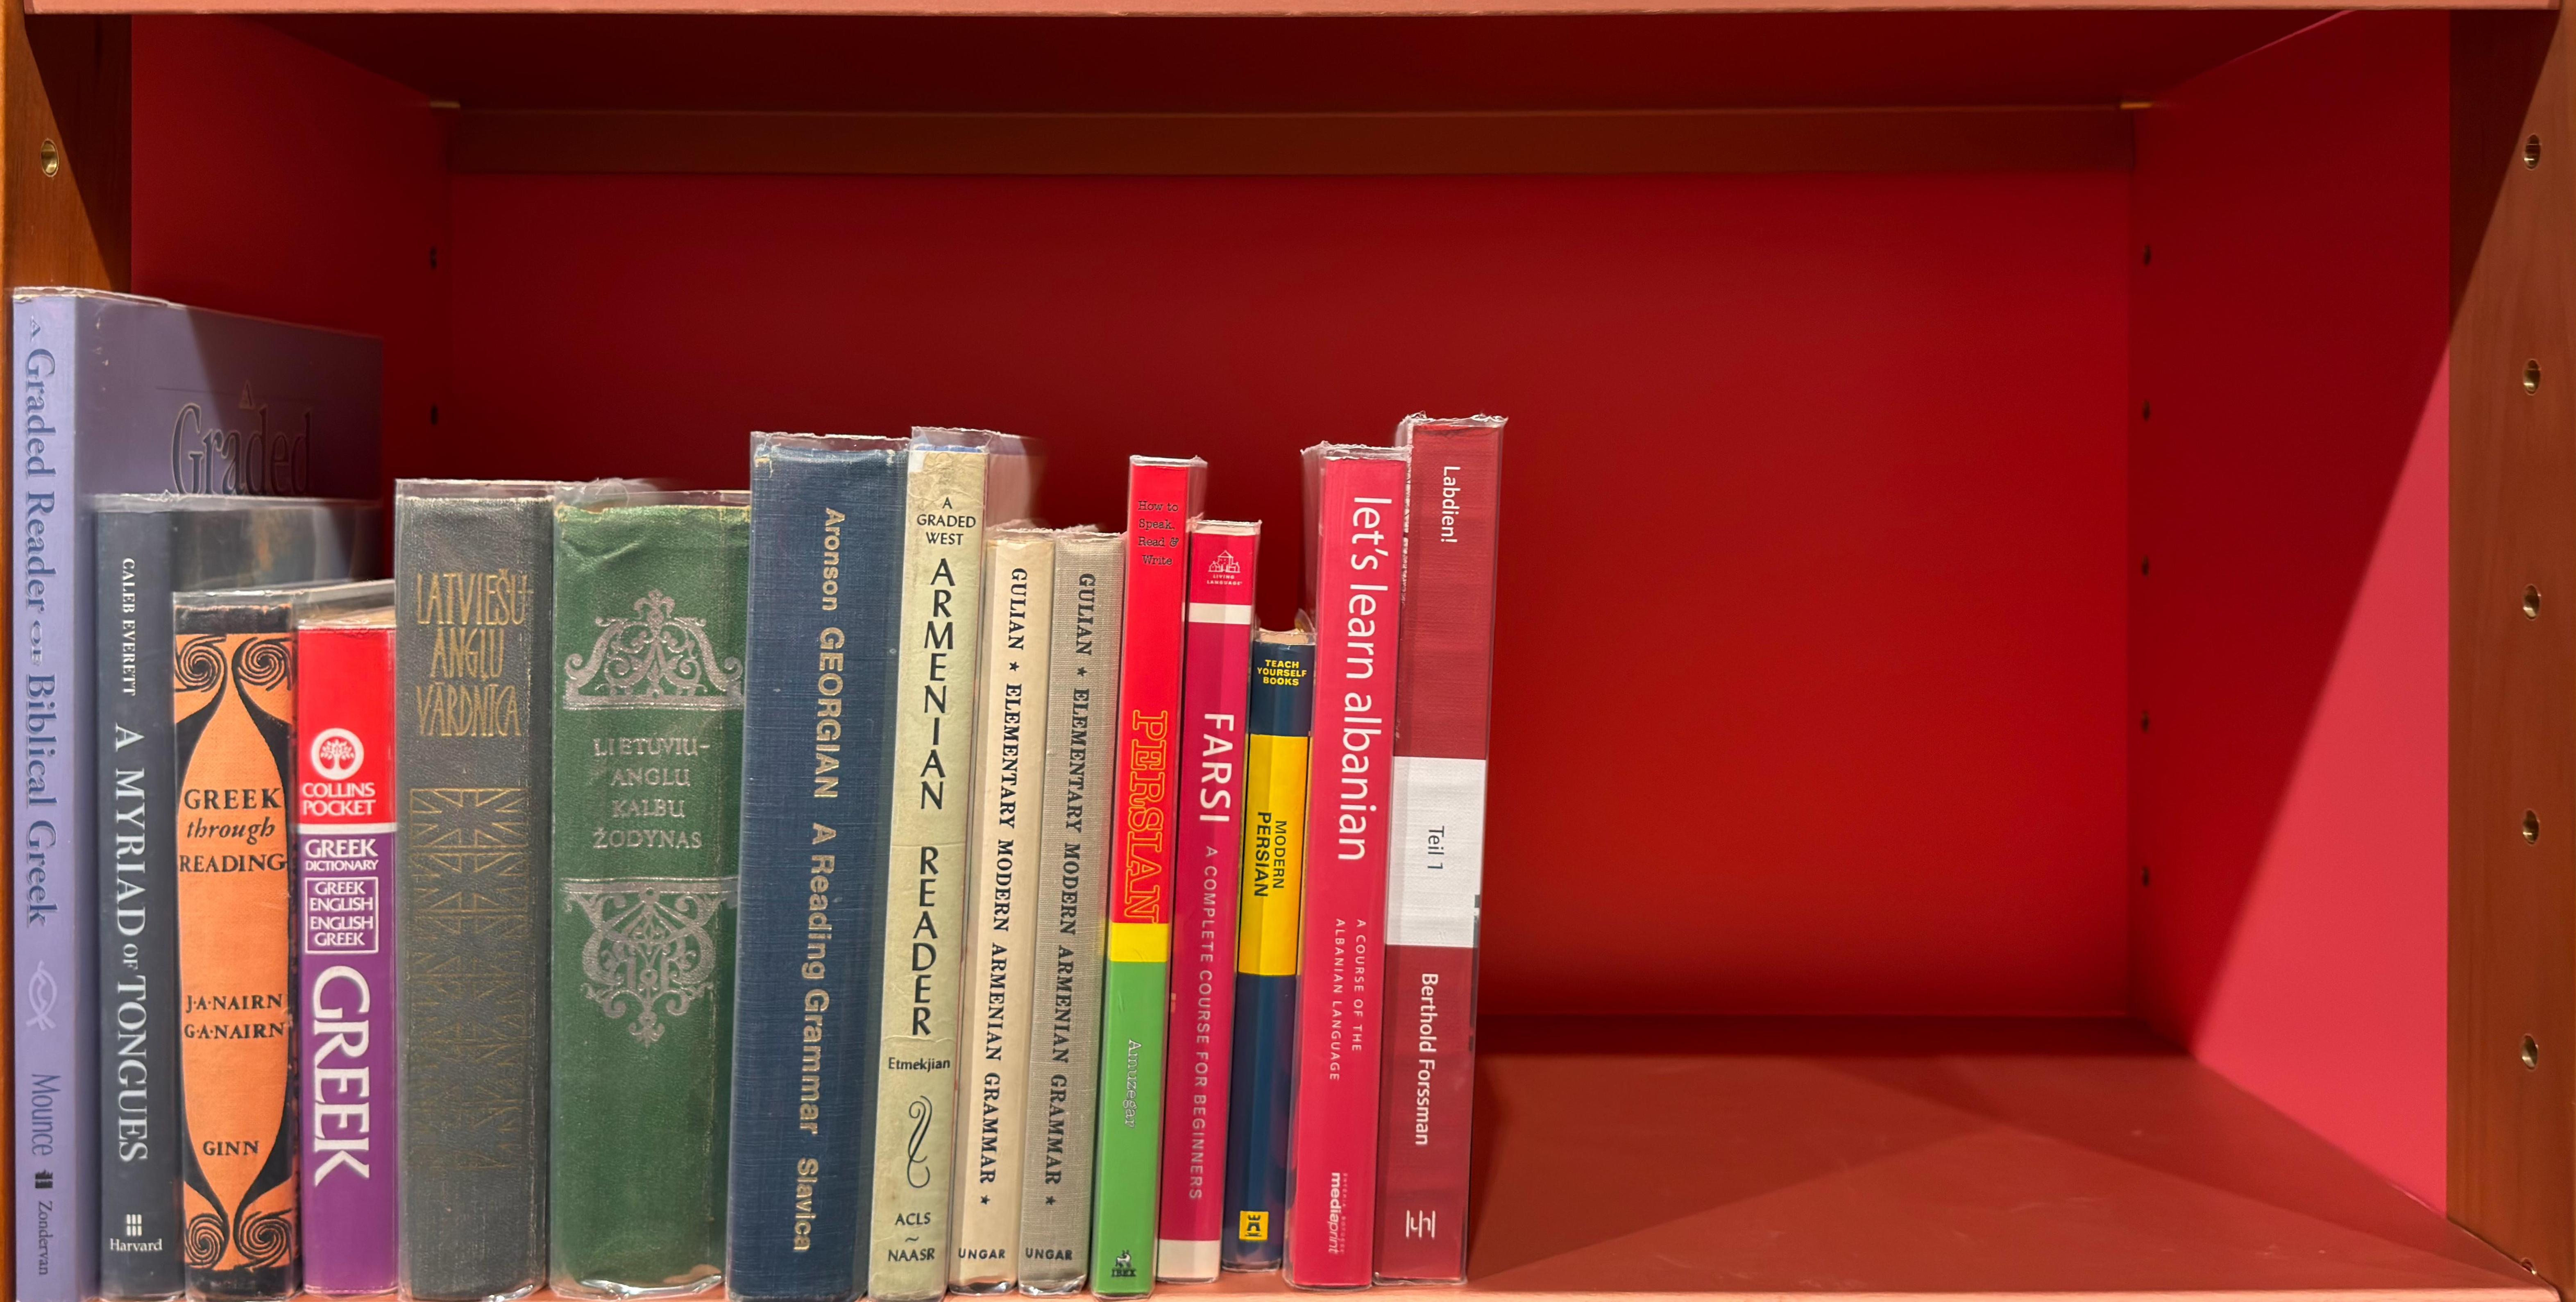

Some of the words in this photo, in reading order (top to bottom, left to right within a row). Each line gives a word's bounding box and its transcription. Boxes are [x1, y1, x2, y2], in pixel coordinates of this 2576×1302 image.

[29, 317, 41, 340] A
[25, 349, 57, 479] Graded
[239, 380, 255, 410] A
[172, 402, 312, 494] Graded
[917, 515, 976, 528] GRADED
[926, 532, 963, 546] WEST
[942, 497, 952, 510] A
[1138, 501, 1163, 510] How
[1167, 503, 1178, 511] to
[1441, 466, 1460, 543] Labdien!
[25, 492, 56, 612] Reader
[821, 508, 846, 611] Aronson
[1138, 536, 1165, 547] Read
[1170, 538, 1179, 547] &
[1142, 555, 1172, 565] Write
[123, 558, 136, 612] CALEB
[1008, 568, 1027, 651] GULIAN
[1076, 573, 1096, 656] GULIAN
[123, 620, 136, 696] EVERETT
[1265, 660, 1299, 669] TEACH
[1347, 585, 1388, 680] learn
[920, 558, 956, 811] ARMENIAN
[1257, 667, 1306, 677] YOURSELF
[1263, 676, 1299, 685] BOOKS
[25, 674, 57, 805] Biblical
[115, 724, 145, 752] A
[814, 627, 845, 798] GEORGIAN
[303, 783, 376, 798] COLLINS
[998, 683, 1022, 830] ELEMENTARY
[1066, 688, 1090, 834] ELEMENTARY
[1199, 714, 1234, 822] FARSI
[1338, 694, 1382, 859] albanian
[184, 789, 282, 810] GREEK
[187, 817, 275, 844] through
[303, 800, 376, 816] POCKET
[812, 822, 837, 844] A
[1123, 710, 1168, 923] PERSIAN
[25, 819, 57, 925] Greek
[115, 769, 146, 936] MYRIAD
[180, 855, 288, 873] READING
[306, 839, 378, 859] GREEK
[306, 860, 379, 872] DICTIONARY
[593, 827, 702, 848] ŽODYNAS
[1205, 846, 1218, 858] A
[1254, 812, 1271, 897] PERSIAN
[1273, 820, 1287, 889] MODERN
[1427, 826, 1444, 859] Teil
[310, 897, 373, 911] ENGLISH
[315, 882, 365, 895] GREEK
[802, 854, 835, 980] Reading
[993, 839, 1015, 932] MODERN
[1060, 842, 1081, 935] MODERN
[1200, 865, 1218, 962] COMPLETE
[123, 944, 139, 970] OF
[310, 916, 373, 931] ENGLISH
[315, 932, 365, 946] GREEK
[910, 846, 939, 1036] READER
[1333, 919, 1346, 996] ALBANIAN
[1354, 935, 1366, 993] COURSE
[986, 942, 1007, 1062] ARMENIAN
[1052, 945, 1074, 1064] ARMENIAN
[1195, 970, 1213, 1044] COURSE
[1352, 1025, 1363, 1051] THE
[1354, 1000, 1363, 1018] OF
[1418, 973, 1438, 1053] Berthold
[118, 975, 148, 1161] TONGUES
[313, 966, 371, 1186] GREEK
[799, 989, 830, 1135] Grammar
[888, 1058, 950, 1071] Etmekjian
[1194, 1052, 1209, 1087] FOR
[1329, 1001, 1342, 1081] LANGUAGE
[32, 1073, 60, 1155] Mounce
[1122, 1039, 1142, 1128] Amuzegar
[1415, 1059, 1435, 1145] Forssman
[203, 1140, 259, 1155] GINN
[980, 1073, 1000, 1184] GRAMMAR
[1045, 1073, 1067, 1185] GRAMMAR
[1189, 1095, 1207, 1199] BEGINNERS
[38, 1201, 53, 1275] Zondervan
[793, 1157, 819, 1252] Slavica
[895, 1211, 931, 1225] ACLS
[1327, 1172, 1341, 1254] mediaprint
[110, 1237, 163, 1253] Harvard
[888, 1248, 935, 1262] NAASR
[958, 1248, 1006, 1260] UNGAR
[1025, 1248, 1073, 1261] UNGAR
